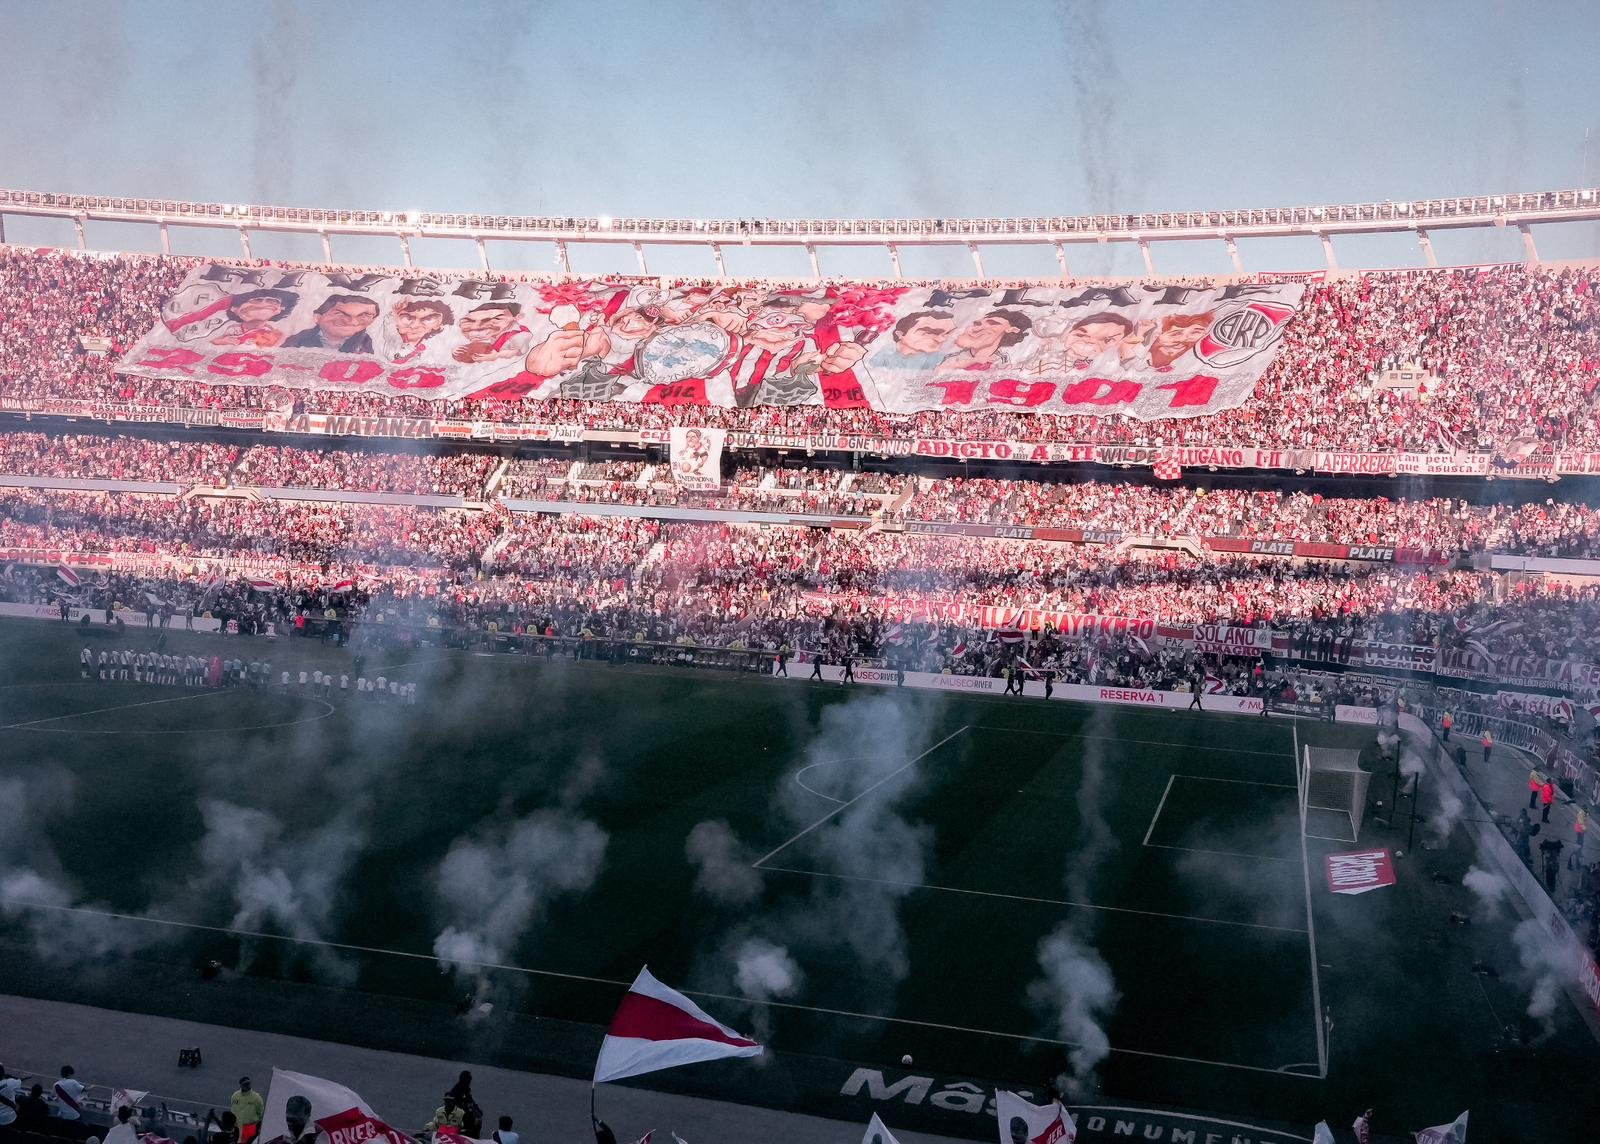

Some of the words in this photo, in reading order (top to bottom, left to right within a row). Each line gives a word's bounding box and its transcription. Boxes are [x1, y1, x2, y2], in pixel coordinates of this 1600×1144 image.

[927, 376, 1220, 408] 1901
[168, 408, 219, 425] BURZACO
[324, 416, 432, 438] MATANZA
[916, 440, 1012, 458] ADICTO
[1030, 445, 1049, 460] A
[1067, 445, 1094, 462] TI
[1180, 450, 1243, 466] LUGANO
[1314, 453, 1394, 472] LAFERRERE
[1398, 464, 1419, 472] que
[909, 524, 946, 534] PLATE
[994, 527, 1032, 539] PLATE
[1251, 541, 1294, 554] PLATE
[1349, 547, 1393, 561] PLATE
[1165, 637, 1184, 648] PAZ
[1195, 625, 1255, 645] SOLANO
[1100, 689, 1155, 703] RESERVA
[331, 1122, 377, 1144] RIVER
